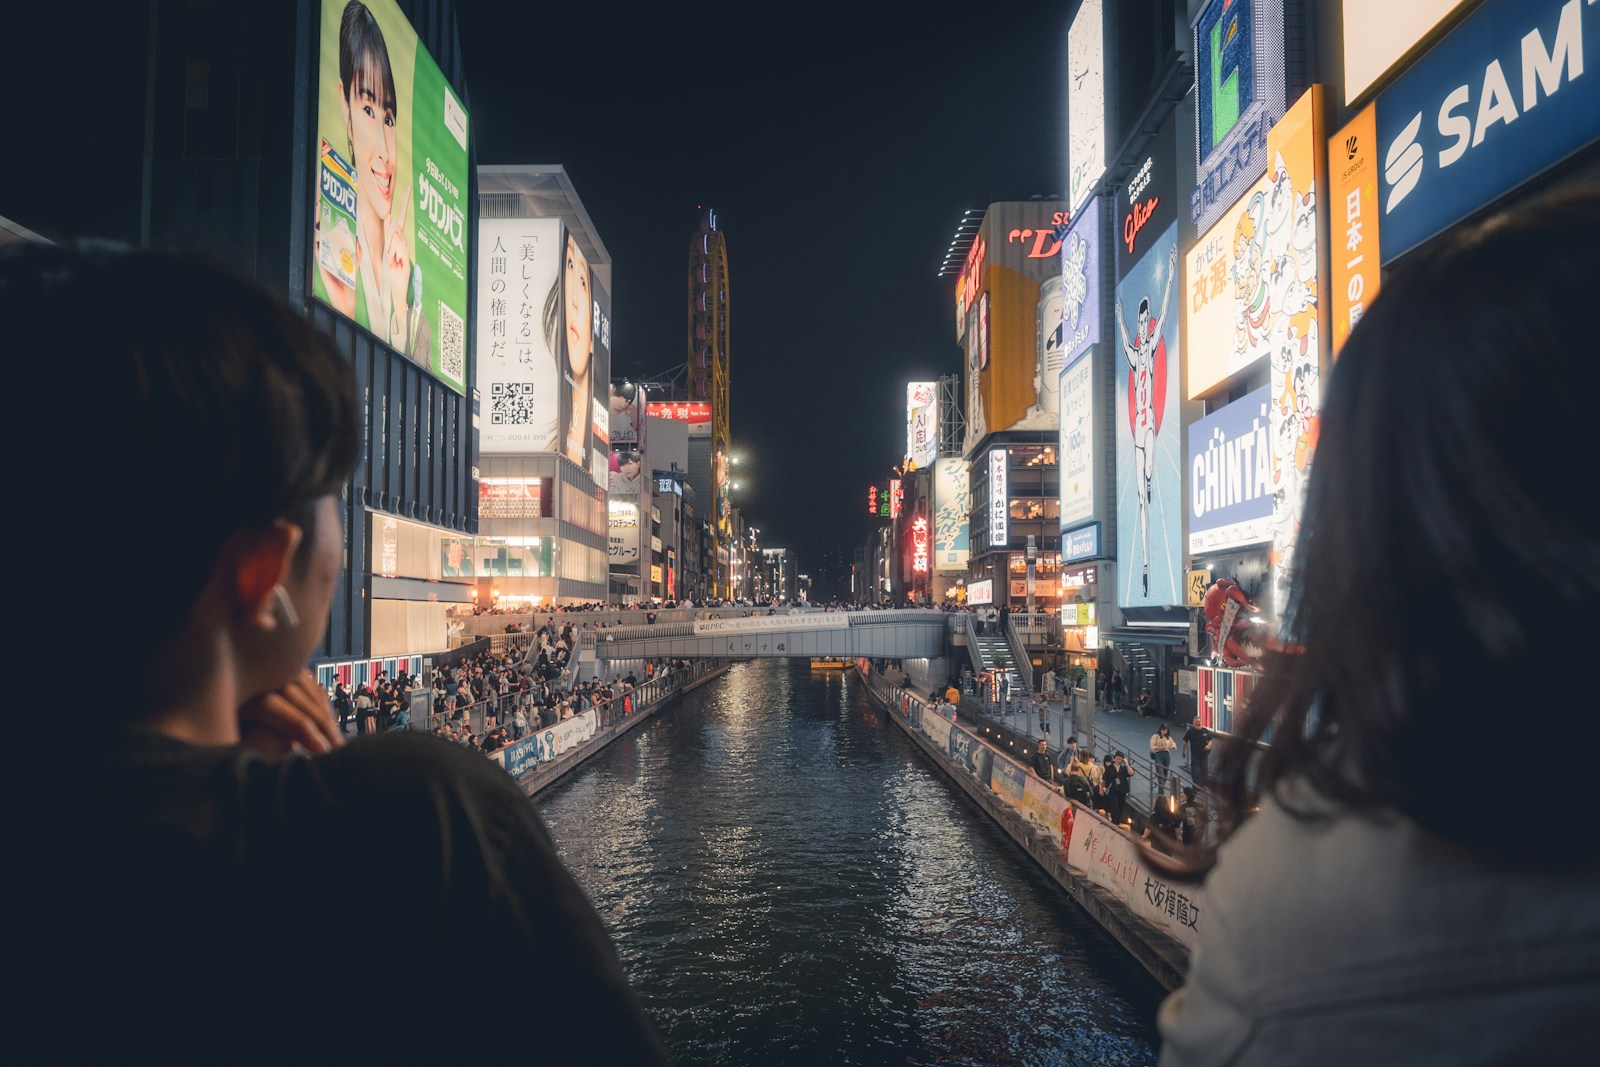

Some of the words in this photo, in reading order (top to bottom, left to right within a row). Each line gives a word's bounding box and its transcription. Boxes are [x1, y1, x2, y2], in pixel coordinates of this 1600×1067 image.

[1438, 0, 1600, 168] SAM
[323, 169, 357, 219] サロンパス
[419, 172, 465, 254] サロンパス
[1125, 197, 1158, 254] Glico
[1196, 236, 1223, 274] かぜに
[490, 236, 507, 366] 人間の権利だ。
[515, 236, 538, 371] 「美しくなる」は、
[1193, 253, 1227, 314] 改源
[661, 407, 689, 419] 免税
[1193, 412, 1273, 518] CHINTA
[995, 499, 1005, 542] かに道楽
[729, 642, 786, 652] えびす橋
